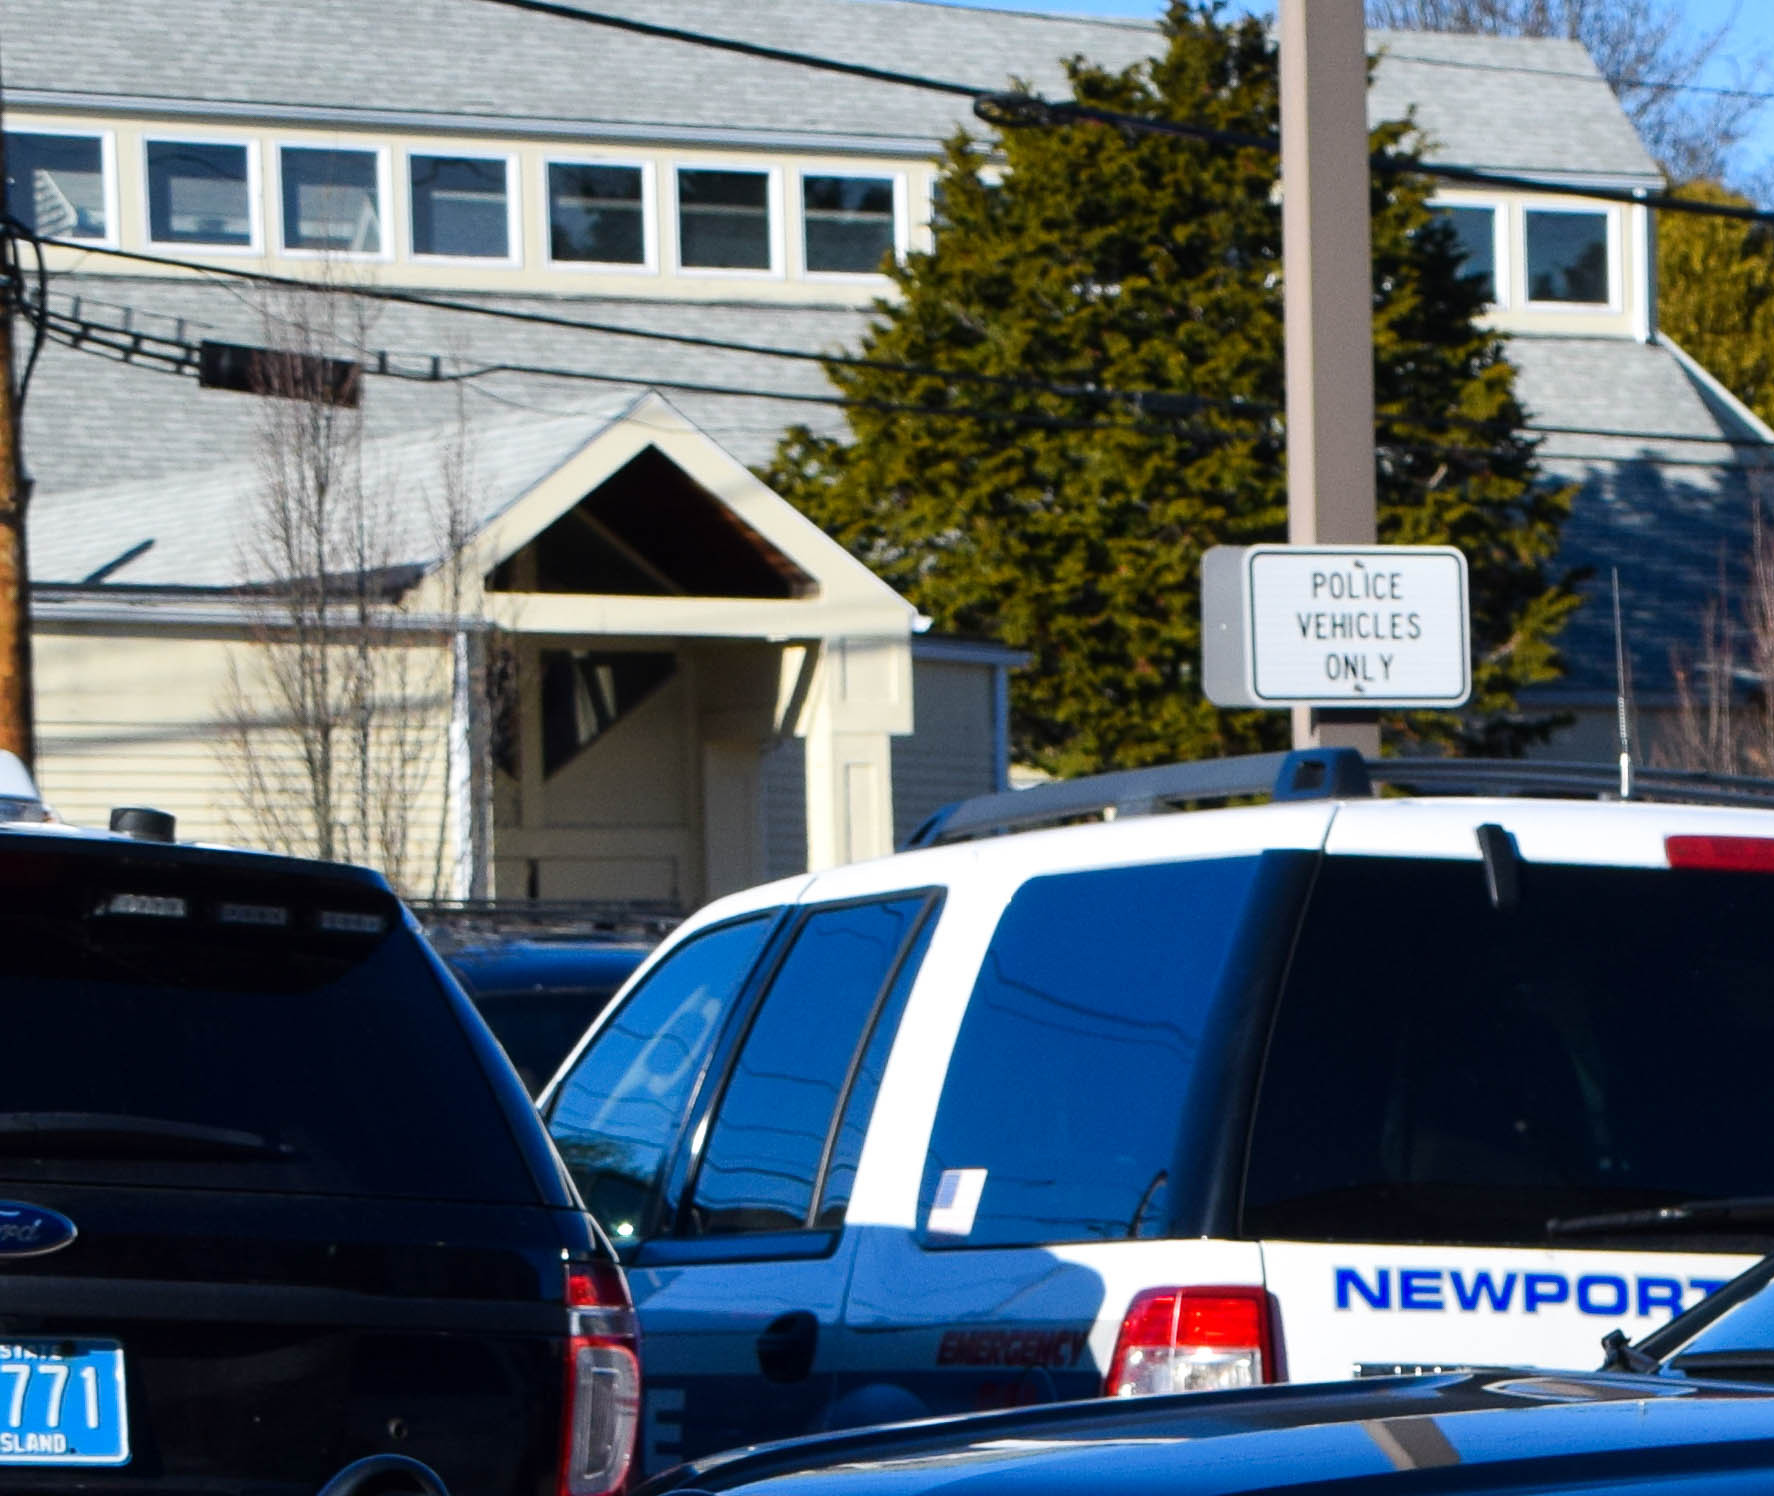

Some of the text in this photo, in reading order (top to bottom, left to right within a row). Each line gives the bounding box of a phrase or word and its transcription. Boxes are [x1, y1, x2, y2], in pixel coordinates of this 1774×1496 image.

[1312, 572, 1404, 600] POLICE
[1297, 612, 1421, 639] VEHICLES
[1326, 653, 1393, 681] ONLY
